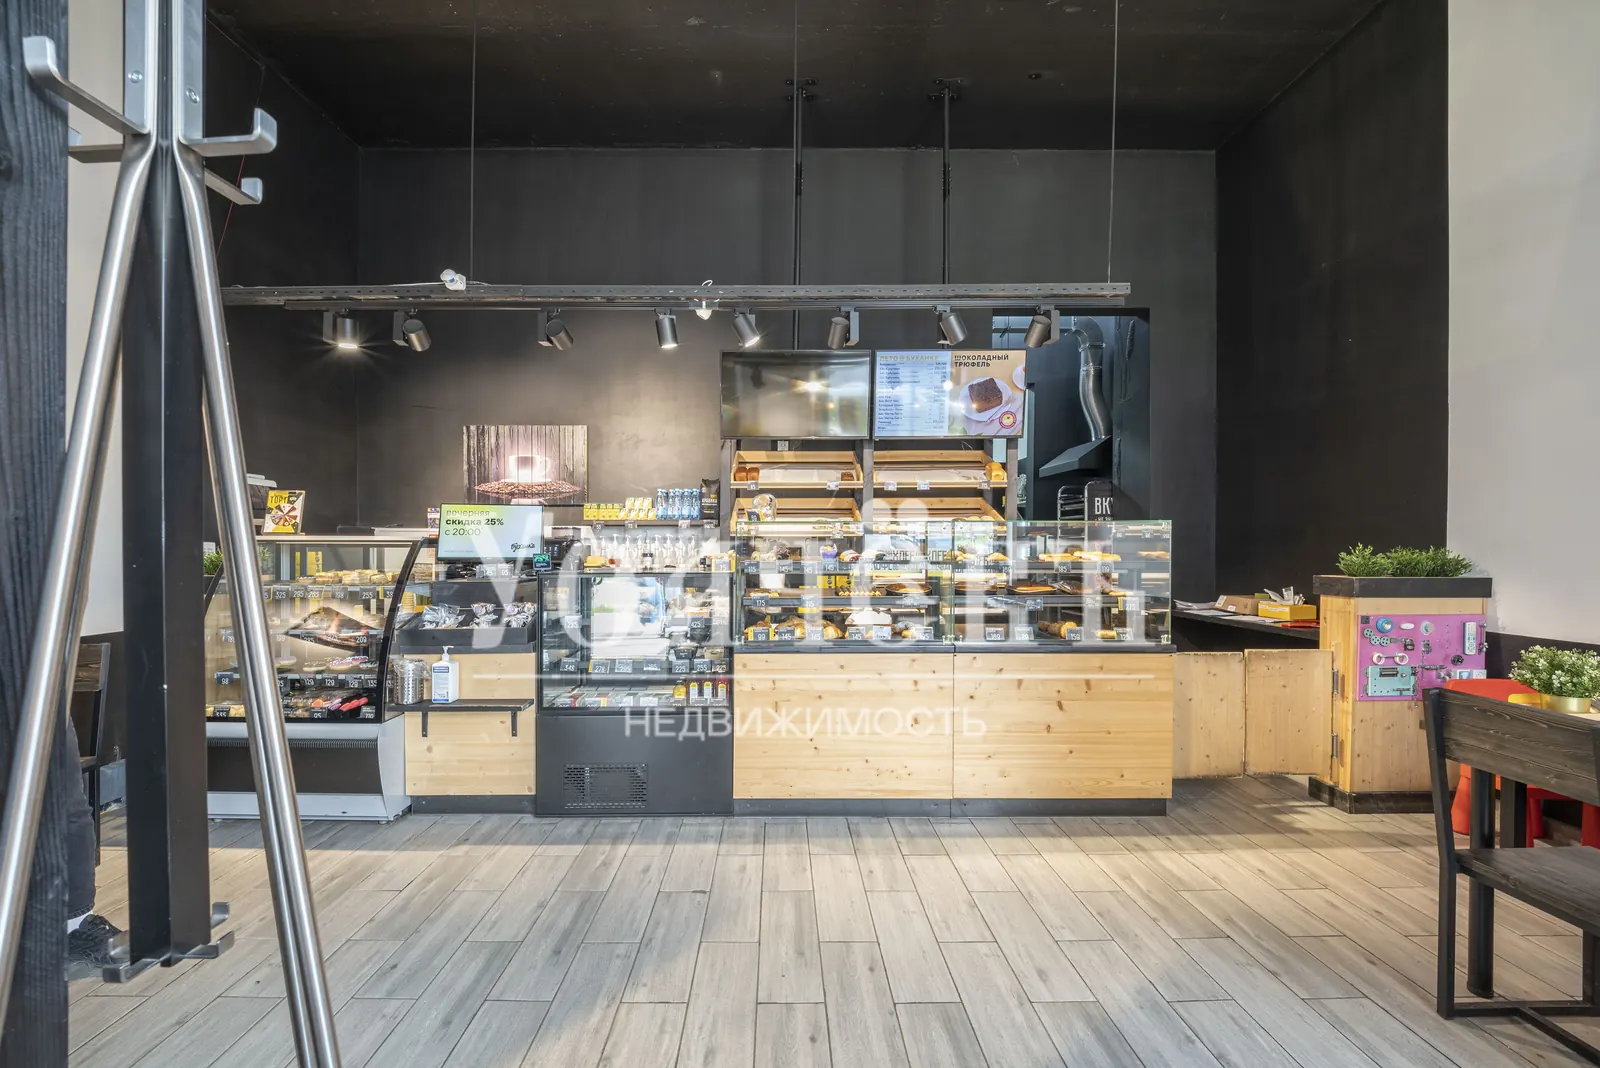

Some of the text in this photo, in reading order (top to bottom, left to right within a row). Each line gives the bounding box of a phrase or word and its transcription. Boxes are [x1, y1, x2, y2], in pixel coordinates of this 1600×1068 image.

[954, 353, 1009, 361] ШОКОЛАДНЫЙ
[1094, 497, 1114, 515] ВК
[446, 510, 490, 518] вечерняя
[445, 518, 504, 527] скидка 25%
